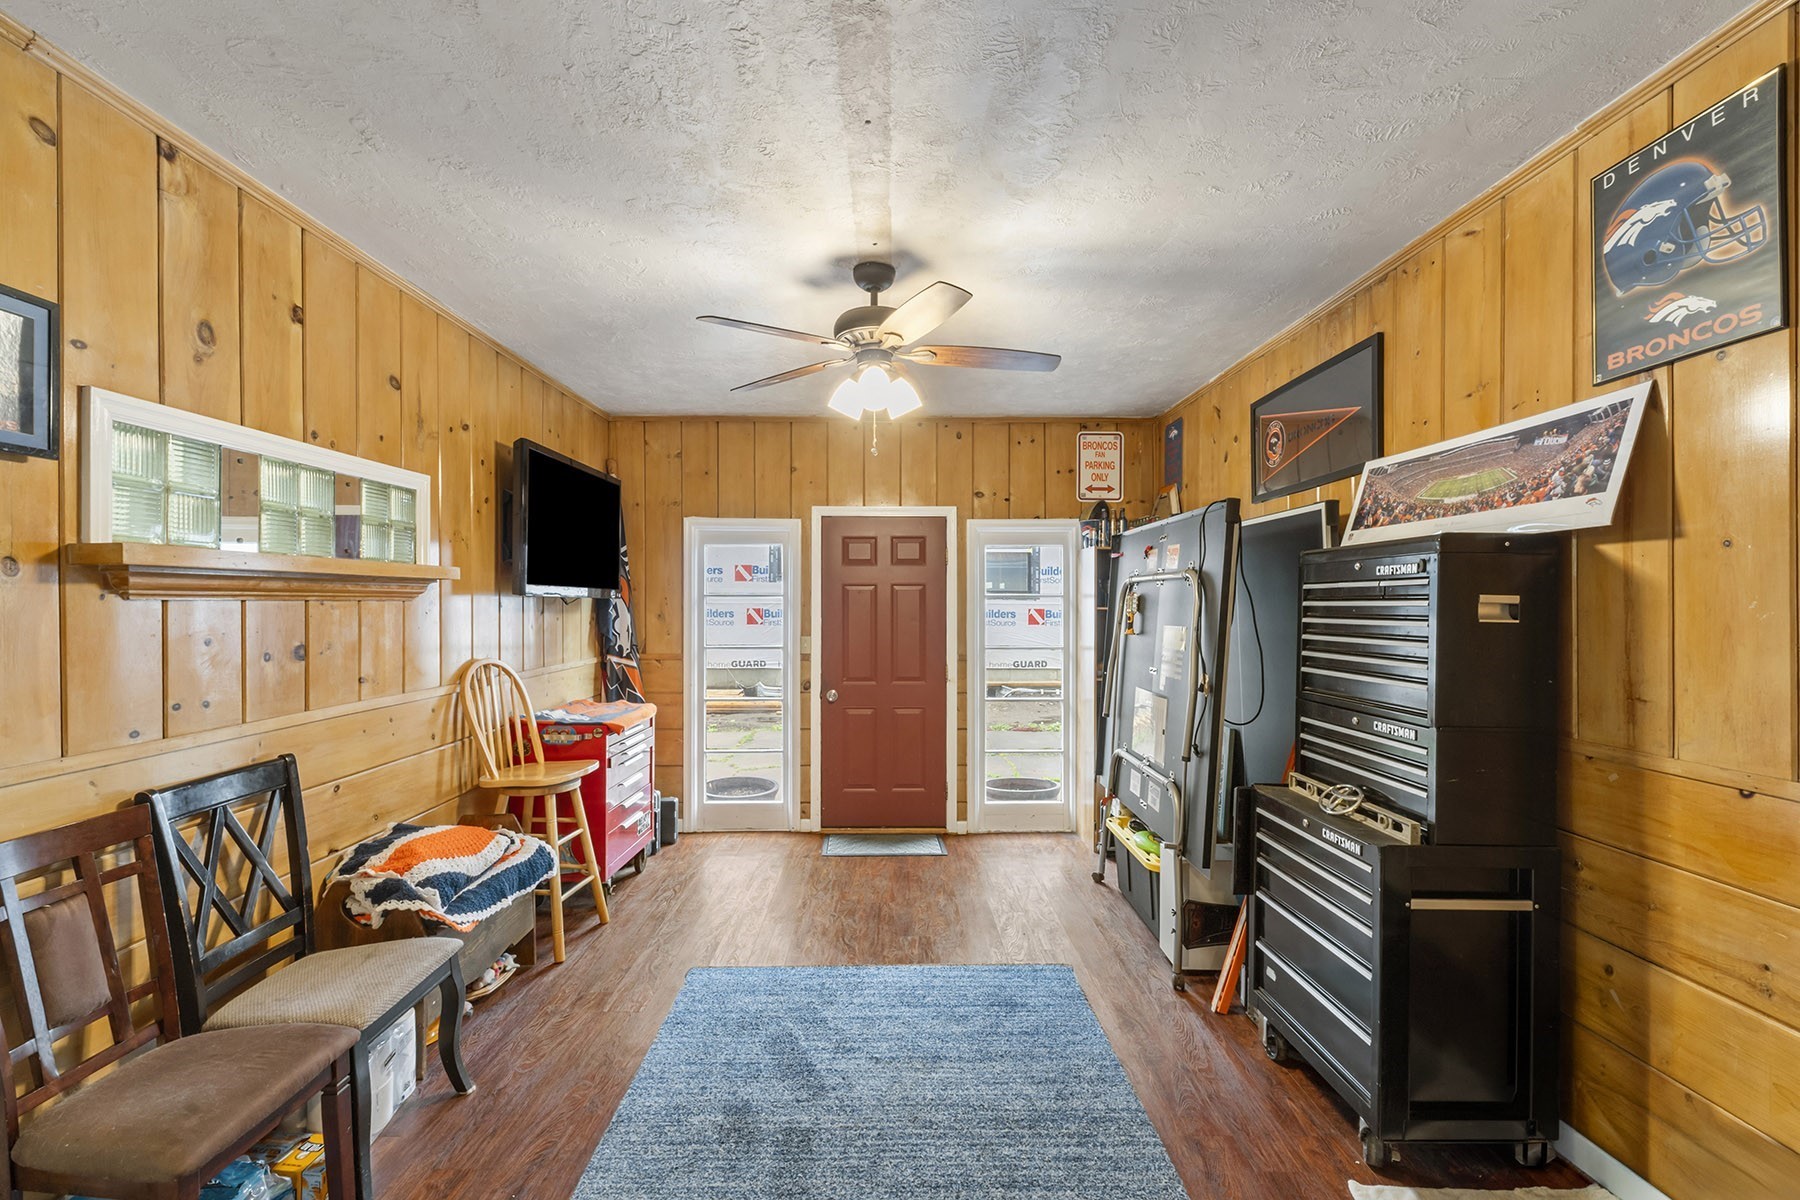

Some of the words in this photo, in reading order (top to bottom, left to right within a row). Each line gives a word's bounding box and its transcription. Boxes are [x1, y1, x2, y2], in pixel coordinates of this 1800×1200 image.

[1603, 86, 1759, 190] DENVER
[1606, 303, 1763, 371] BRONCOS
[1082, 441, 1119, 451] BRONCOS
[1085, 461, 1116, 470] PARKING
[1090, 472, 1109, 482] ONLY
[1376, 562, 1418, 576] CRAFTSMAN
[1373, 720, 1416, 741] CRAFTSMAN
[1321, 827, 1362, 856] CRAFTSMAN
